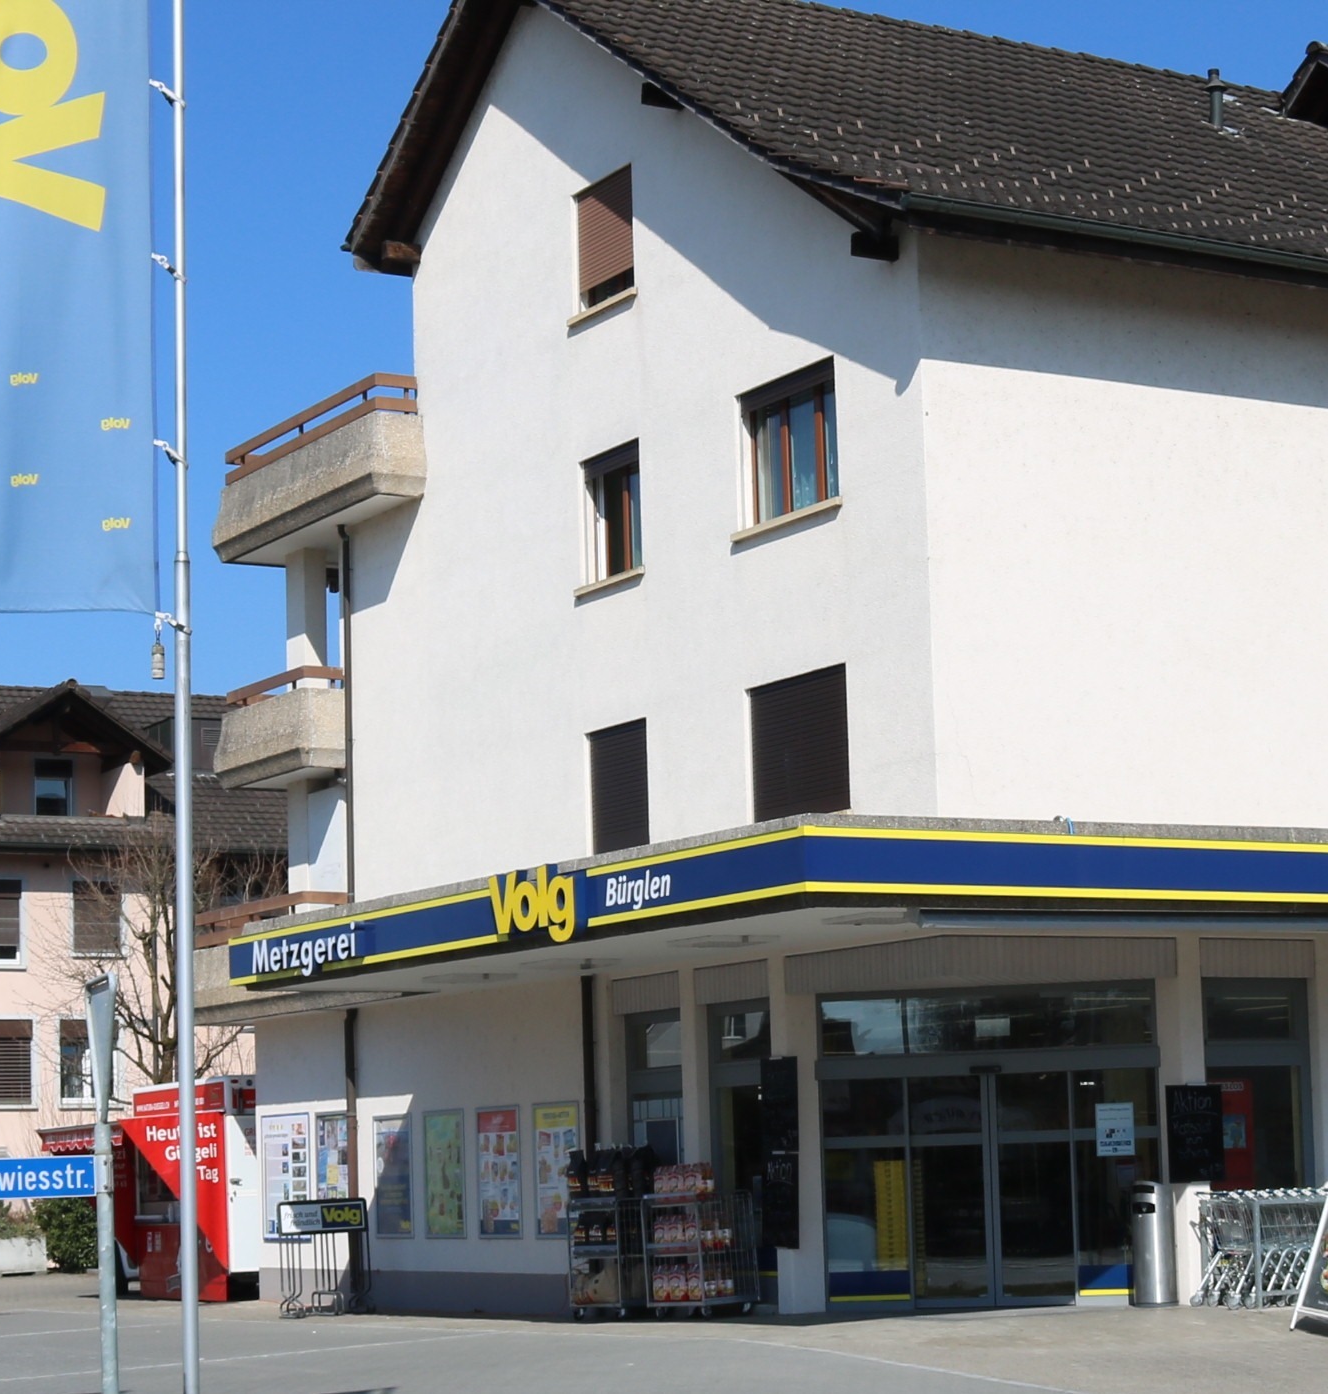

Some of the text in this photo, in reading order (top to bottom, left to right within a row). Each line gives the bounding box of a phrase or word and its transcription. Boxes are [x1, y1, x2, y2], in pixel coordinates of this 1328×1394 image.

[488, 866, 574, 942] Volg
[605, 872, 671, 911] Bürglen
[252, 922, 356, 977] Metzgerei
[146, 1123, 217, 1142] Heut ist
[196, 1165, 219, 1183] Tag
[323, 1206, 361, 1225] Volg
